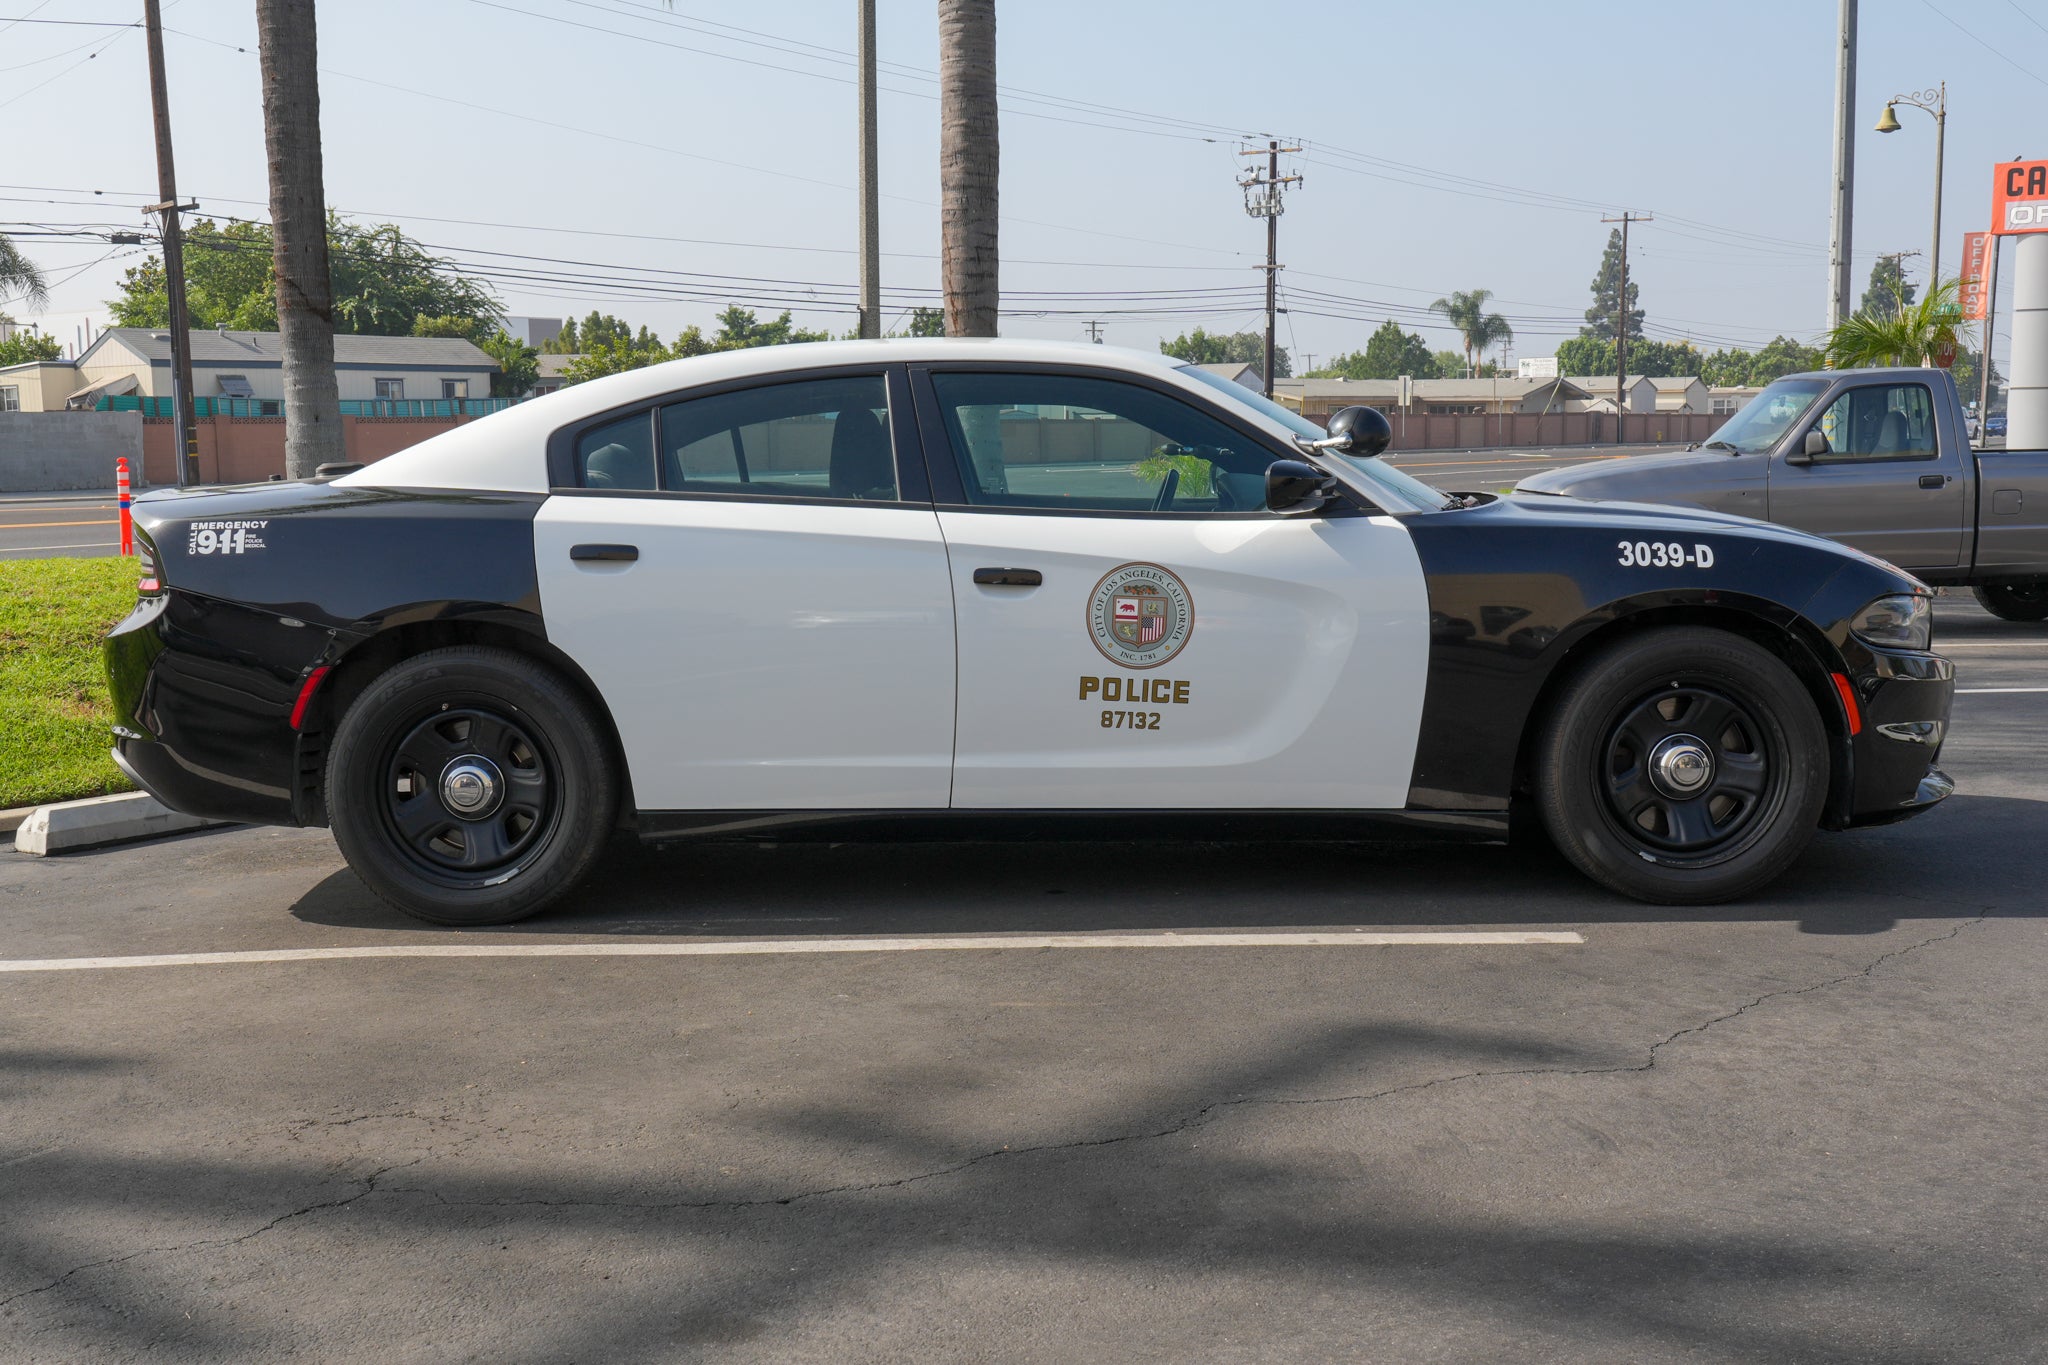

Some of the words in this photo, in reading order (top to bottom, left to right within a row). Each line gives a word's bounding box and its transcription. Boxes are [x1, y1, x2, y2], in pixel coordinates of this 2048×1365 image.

[2006, 166, 2047, 197] CA
[191, 521, 268, 530] EMERGENCY
[189, 530, 198, 555] CALL
[1617, 540, 1715, 568] 3039-D
[1102, 578, 1118, 596] LOS
[1119, 569, 1165, 585] ANGELES,
[1095, 597, 1105, 611] OF
[1166, 581, 1186, 640] CALIFORNIA
[1094, 614, 1106, 638] CITY
[1119, 651, 1137, 661] INC.
[1140, 652, 1157, 661] 1781
[1079, 676, 1190, 704] POLICE
[1100, 710, 1161, 730] 87132
